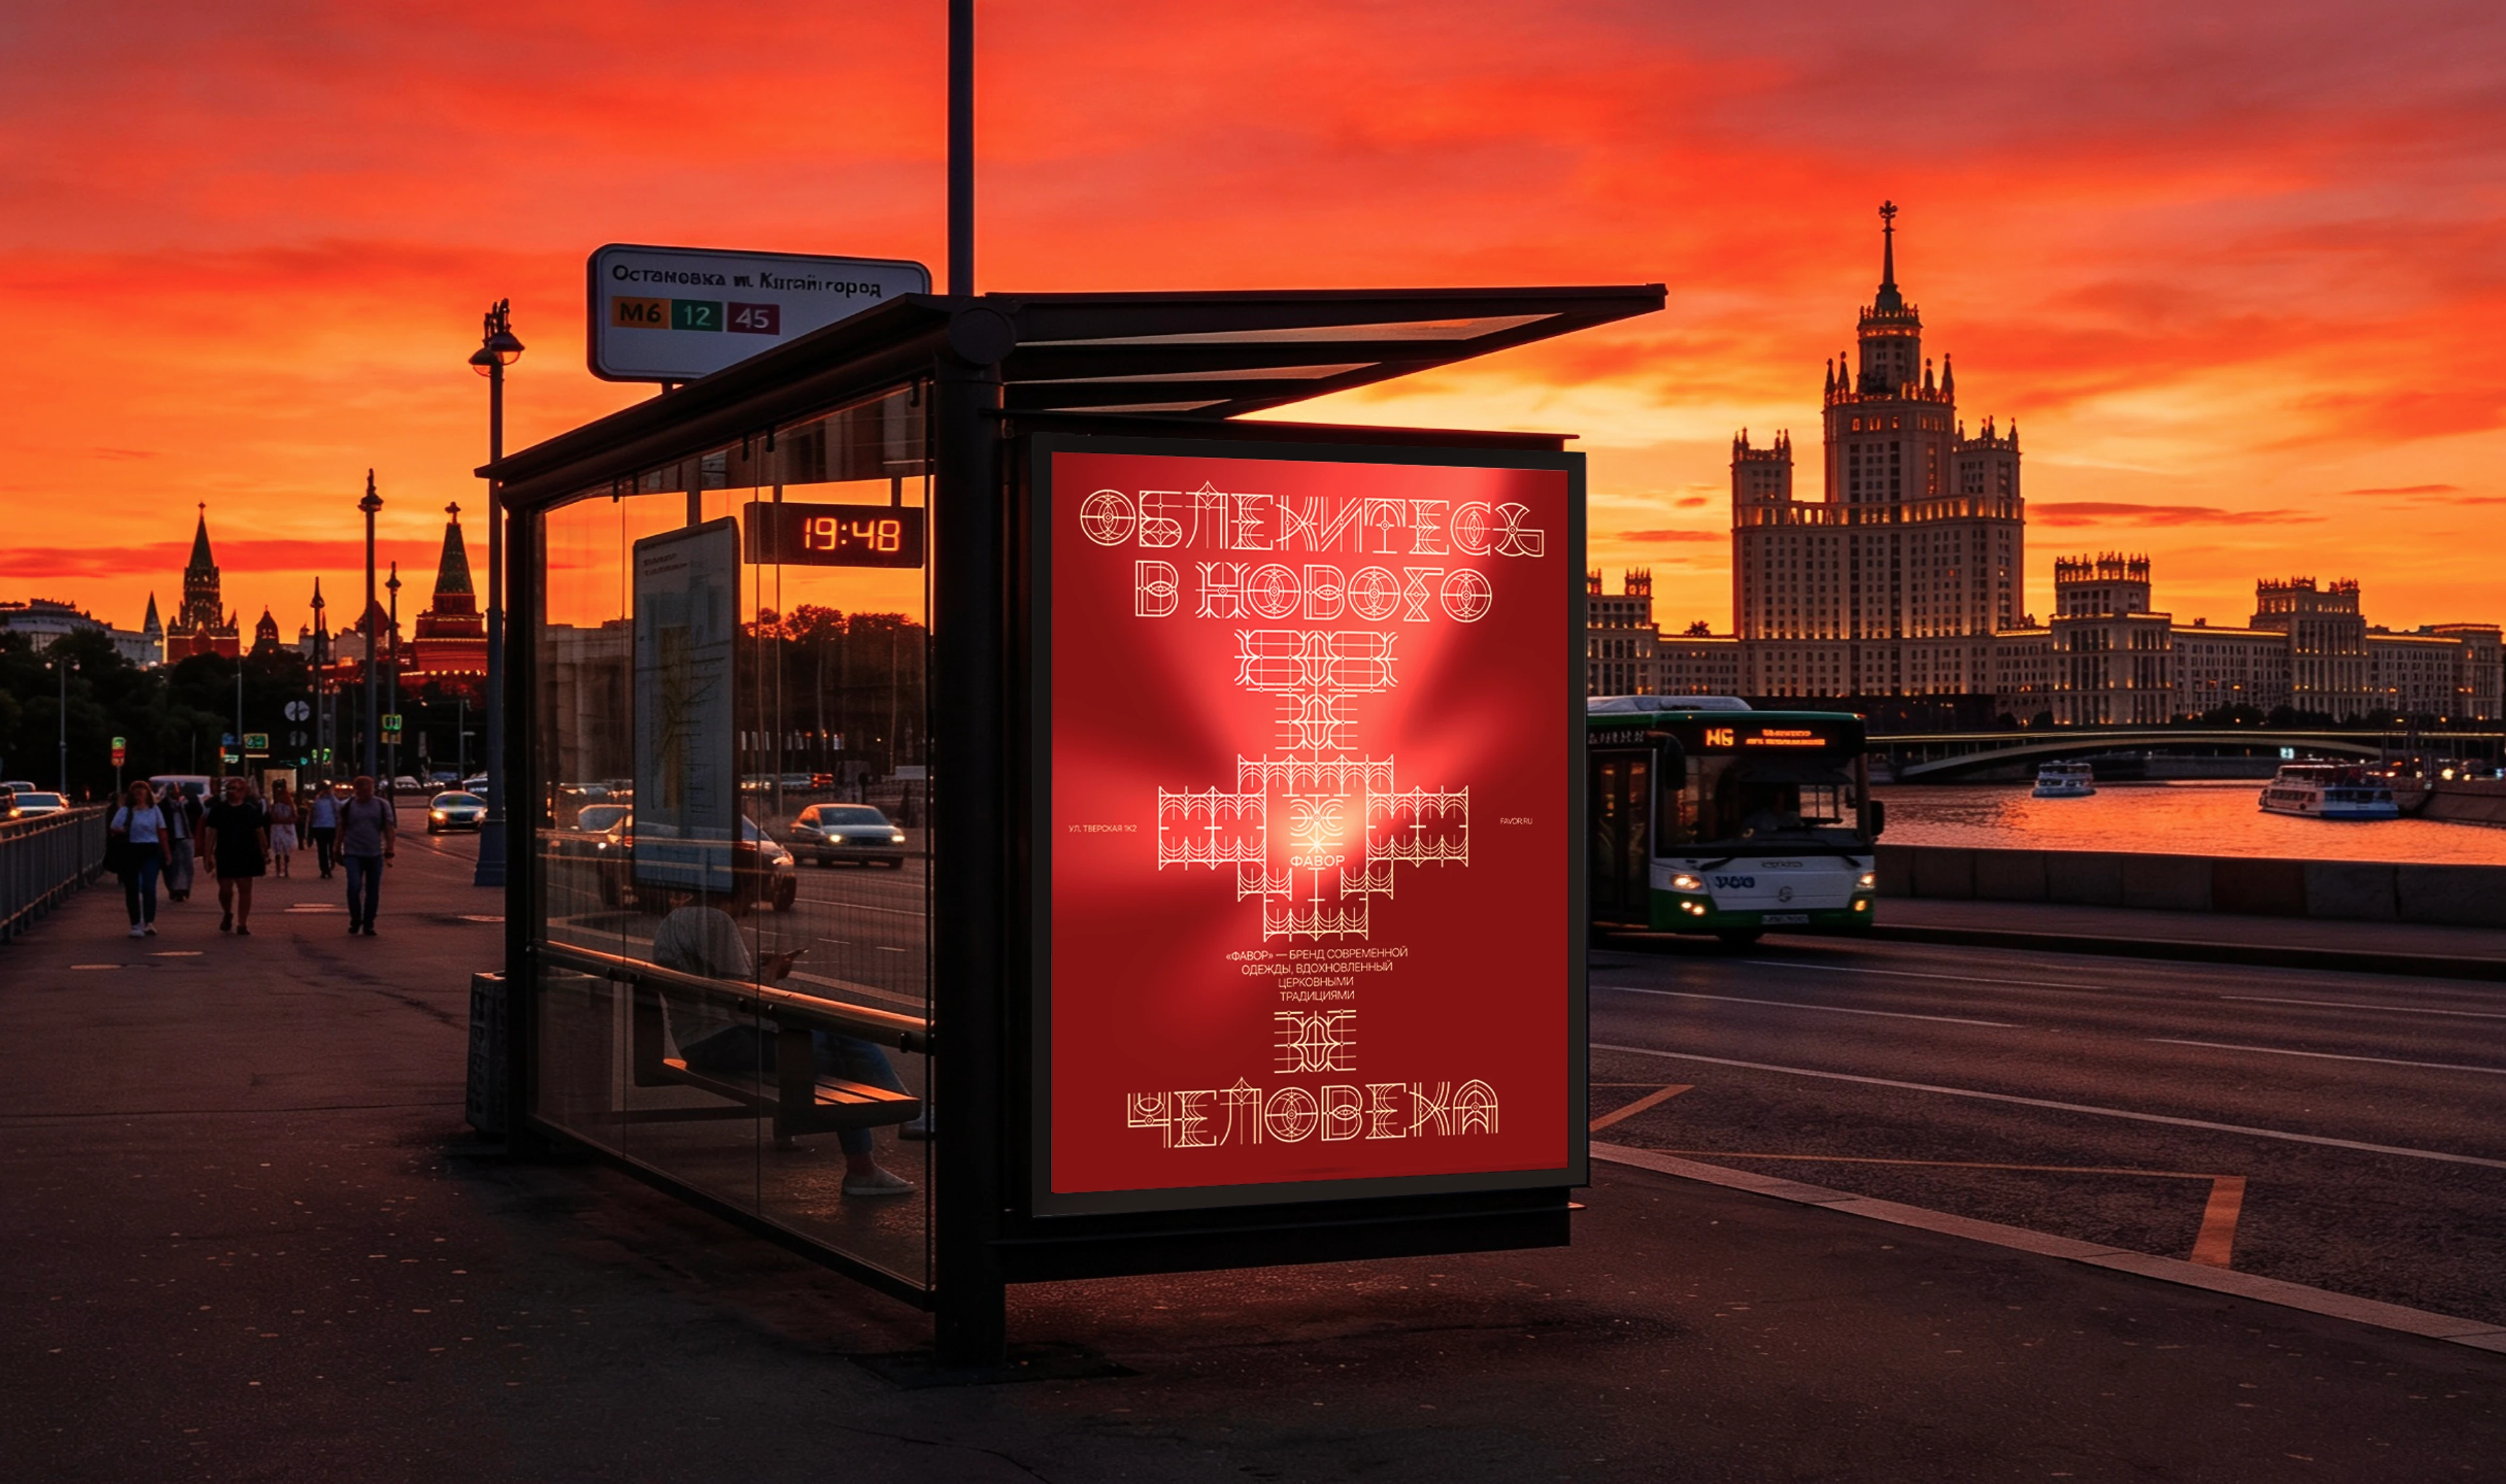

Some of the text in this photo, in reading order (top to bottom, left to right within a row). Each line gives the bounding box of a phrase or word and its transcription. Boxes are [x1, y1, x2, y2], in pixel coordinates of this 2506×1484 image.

[612, 264, 726, 286] Остановка
[684, 305, 712, 326] 12
[735, 307, 769, 329] 45
[805, 518, 900, 551] 19:48
[1135, 560, 1493, 623] В НОВОГО
[1068, 824, 1081, 833] УЛ.
[1083, 824, 1122, 833] ТВЕРСКАЯ
[1290, 855, 1345, 867] ФАВОР
[1226, 950, 1273, 961] «ФАВОР»
[1289, 949, 1325, 961] БРЕНД
[1327, 946, 1408, 959] СОВРЕМЕННОЙ
[1241, 959, 1393, 976] ОДЕЖДЫ, ВДОХНОВЛЕННЫЙ
[1278, 976, 1354, 989] ЦЕРКОВНЫМИ
[1280, 990, 1355, 1002] ТРАДИЦИЯМИ
[1127, 1077, 1498, 1149] ЧЕЛОВЕКА
